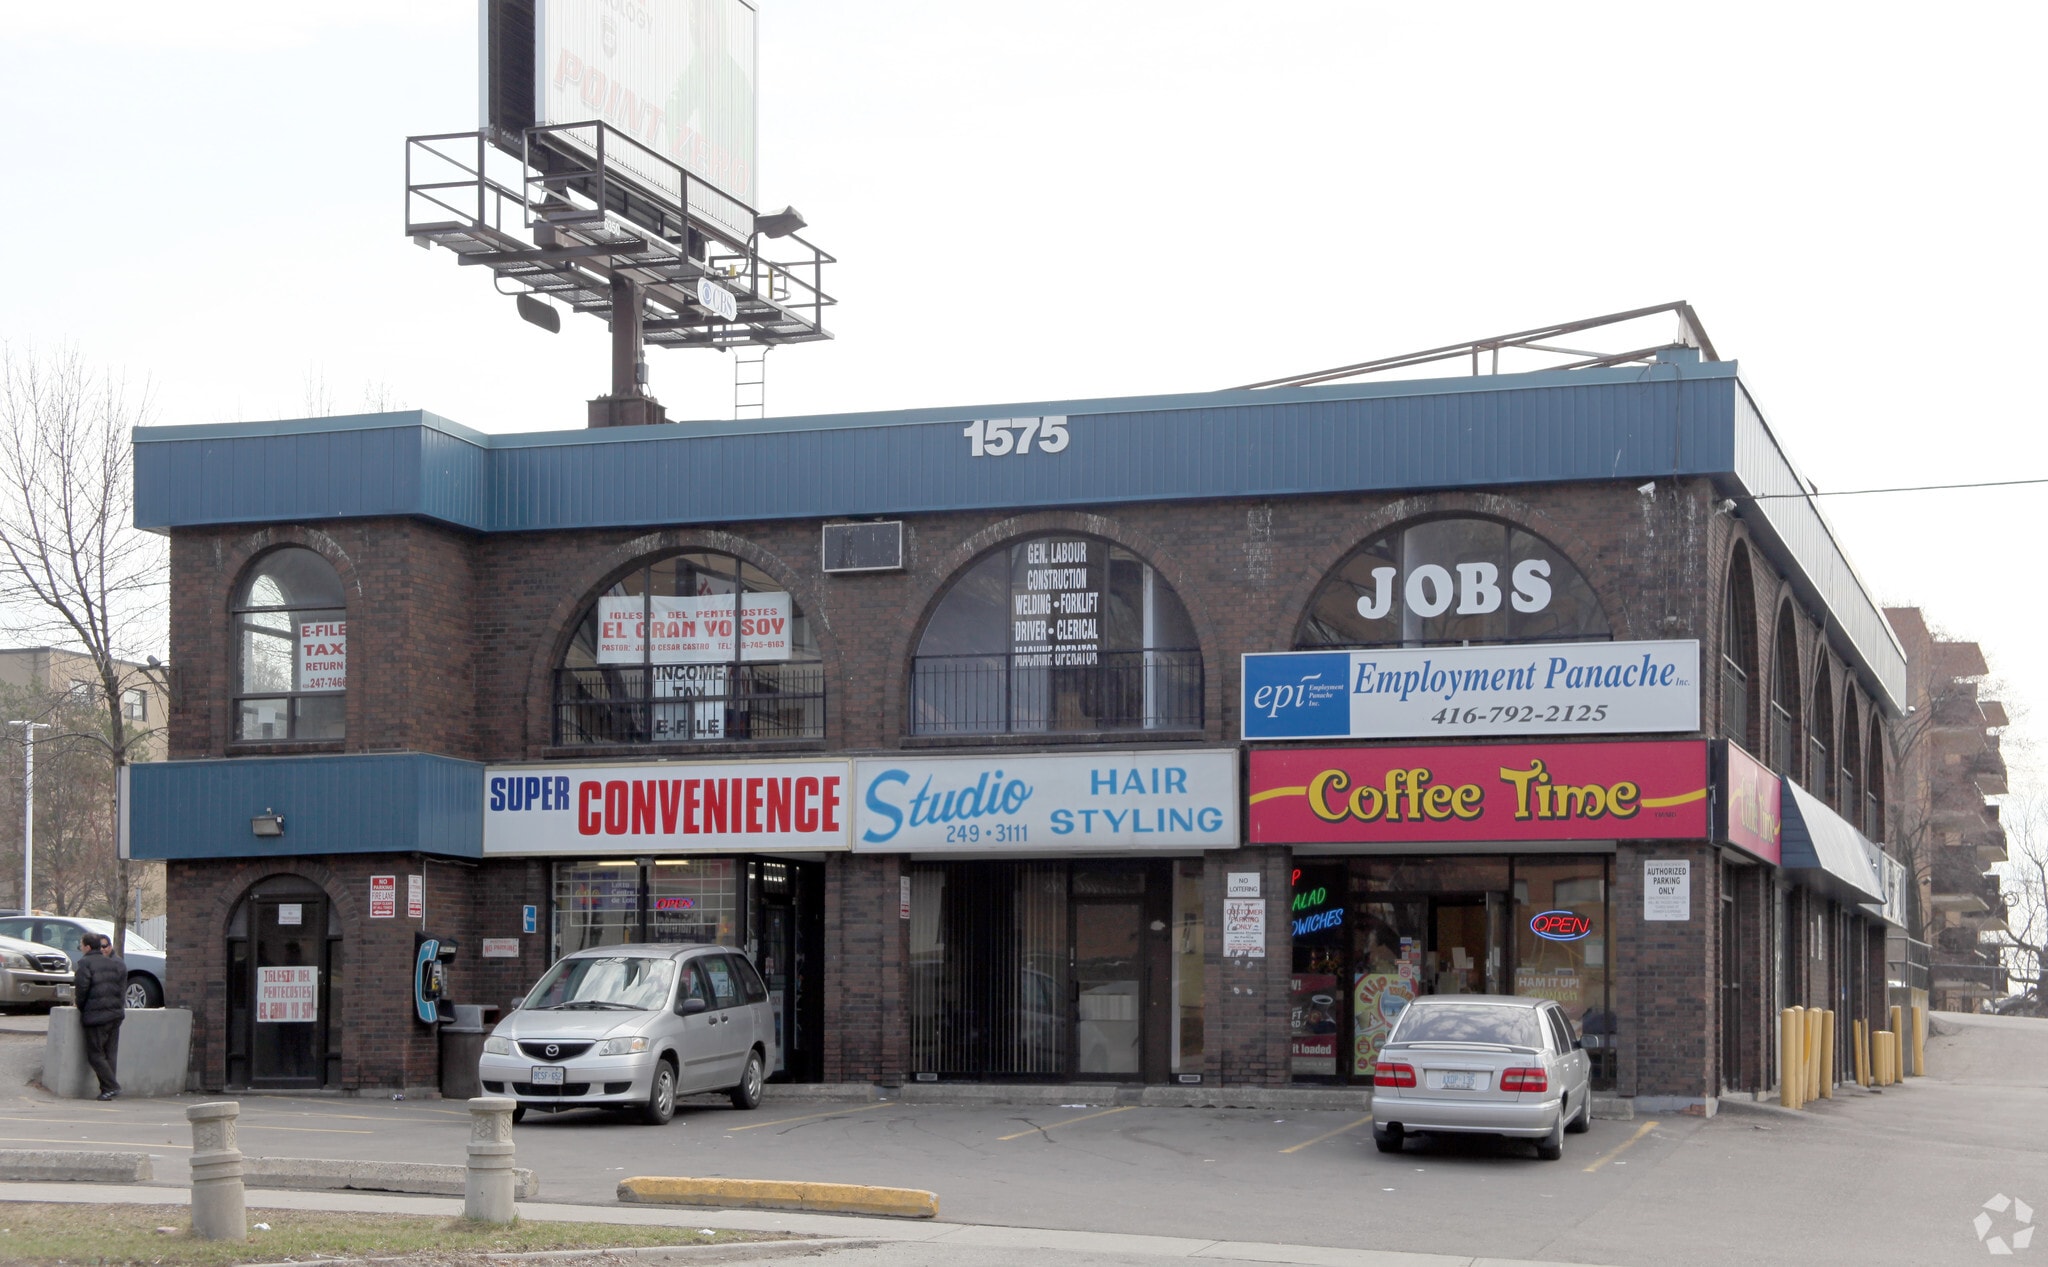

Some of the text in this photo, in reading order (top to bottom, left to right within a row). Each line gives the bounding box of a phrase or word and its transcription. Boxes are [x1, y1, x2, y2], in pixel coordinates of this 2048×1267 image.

[554, 47, 750, 195] POINT ZERO
[712, 288, 733, 317] CBS
[963, 415, 1070, 457] 1575
[1028, 541, 1087, 564] GEN. LABOUR
[1027, 568, 1087, 590] CONSTRUCTION
[1356, 559, 1553, 620] JOBS
[1015, 592, 1099, 615] WELDING FORKLIFT
[610, 611, 656, 620] IGLESA
[668, 610, 688, 619] DEL
[302, 623, 346, 637] E-FILE
[602, 621, 627, 639] EL
[704, 620, 732, 638] YO
[741, 618, 785, 636] SOY
[1015, 618, 1099, 642] DRIVER CLERICAL
[304, 643, 344, 656] TAX
[601, 644, 631, 652] PASTOR:
[635, 644, 656, 652] JUO
[658, 643, 680, 651] CESAR
[1055, 644, 1099, 665] OPERATOR
[305, 661, 344, 671] RETURN
[656, 665, 724, 680] INCOME
[1352, 653, 1691, 702] Employment Panache Inc.
[672, 686, 705, 697] TAX
[1308, 684, 1344, 692] Employment
[1431, 703, 1609, 725] 416-792-2125
[656, 720, 719, 734] E-FLE
[1090, 767, 1188, 796] HAIR
[1308, 758, 1642, 823] Coffee Time
[490, 776, 841, 836] SUPER CONVENIENCE
[862, 769, 1034, 844] Studio
[1049, 806, 1224, 836] STYLING
[946, 824, 1028, 843] 249 3111
[1647, 867, 1687, 876] AUTHORIZED
[1653, 877, 1681, 885] PARKING
[372, 891, 394, 900] FIRE LANE
[1292, 887, 1326, 911] ALAD
[1658, 887, 1675, 895] ONLY
[656, 897, 693, 910] OPEN
[1292, 908, 1344, 936] DWICHES
[1533, 916, 1591, 934] OPEN
[264, 970, 295, 982] IGLESIA
[1519, 977, 1579, 988] HAM IT UP!
[264, 985, 311, 999] PENTECOSTES
[1292, 1044, 1332, 1054] it loaded
